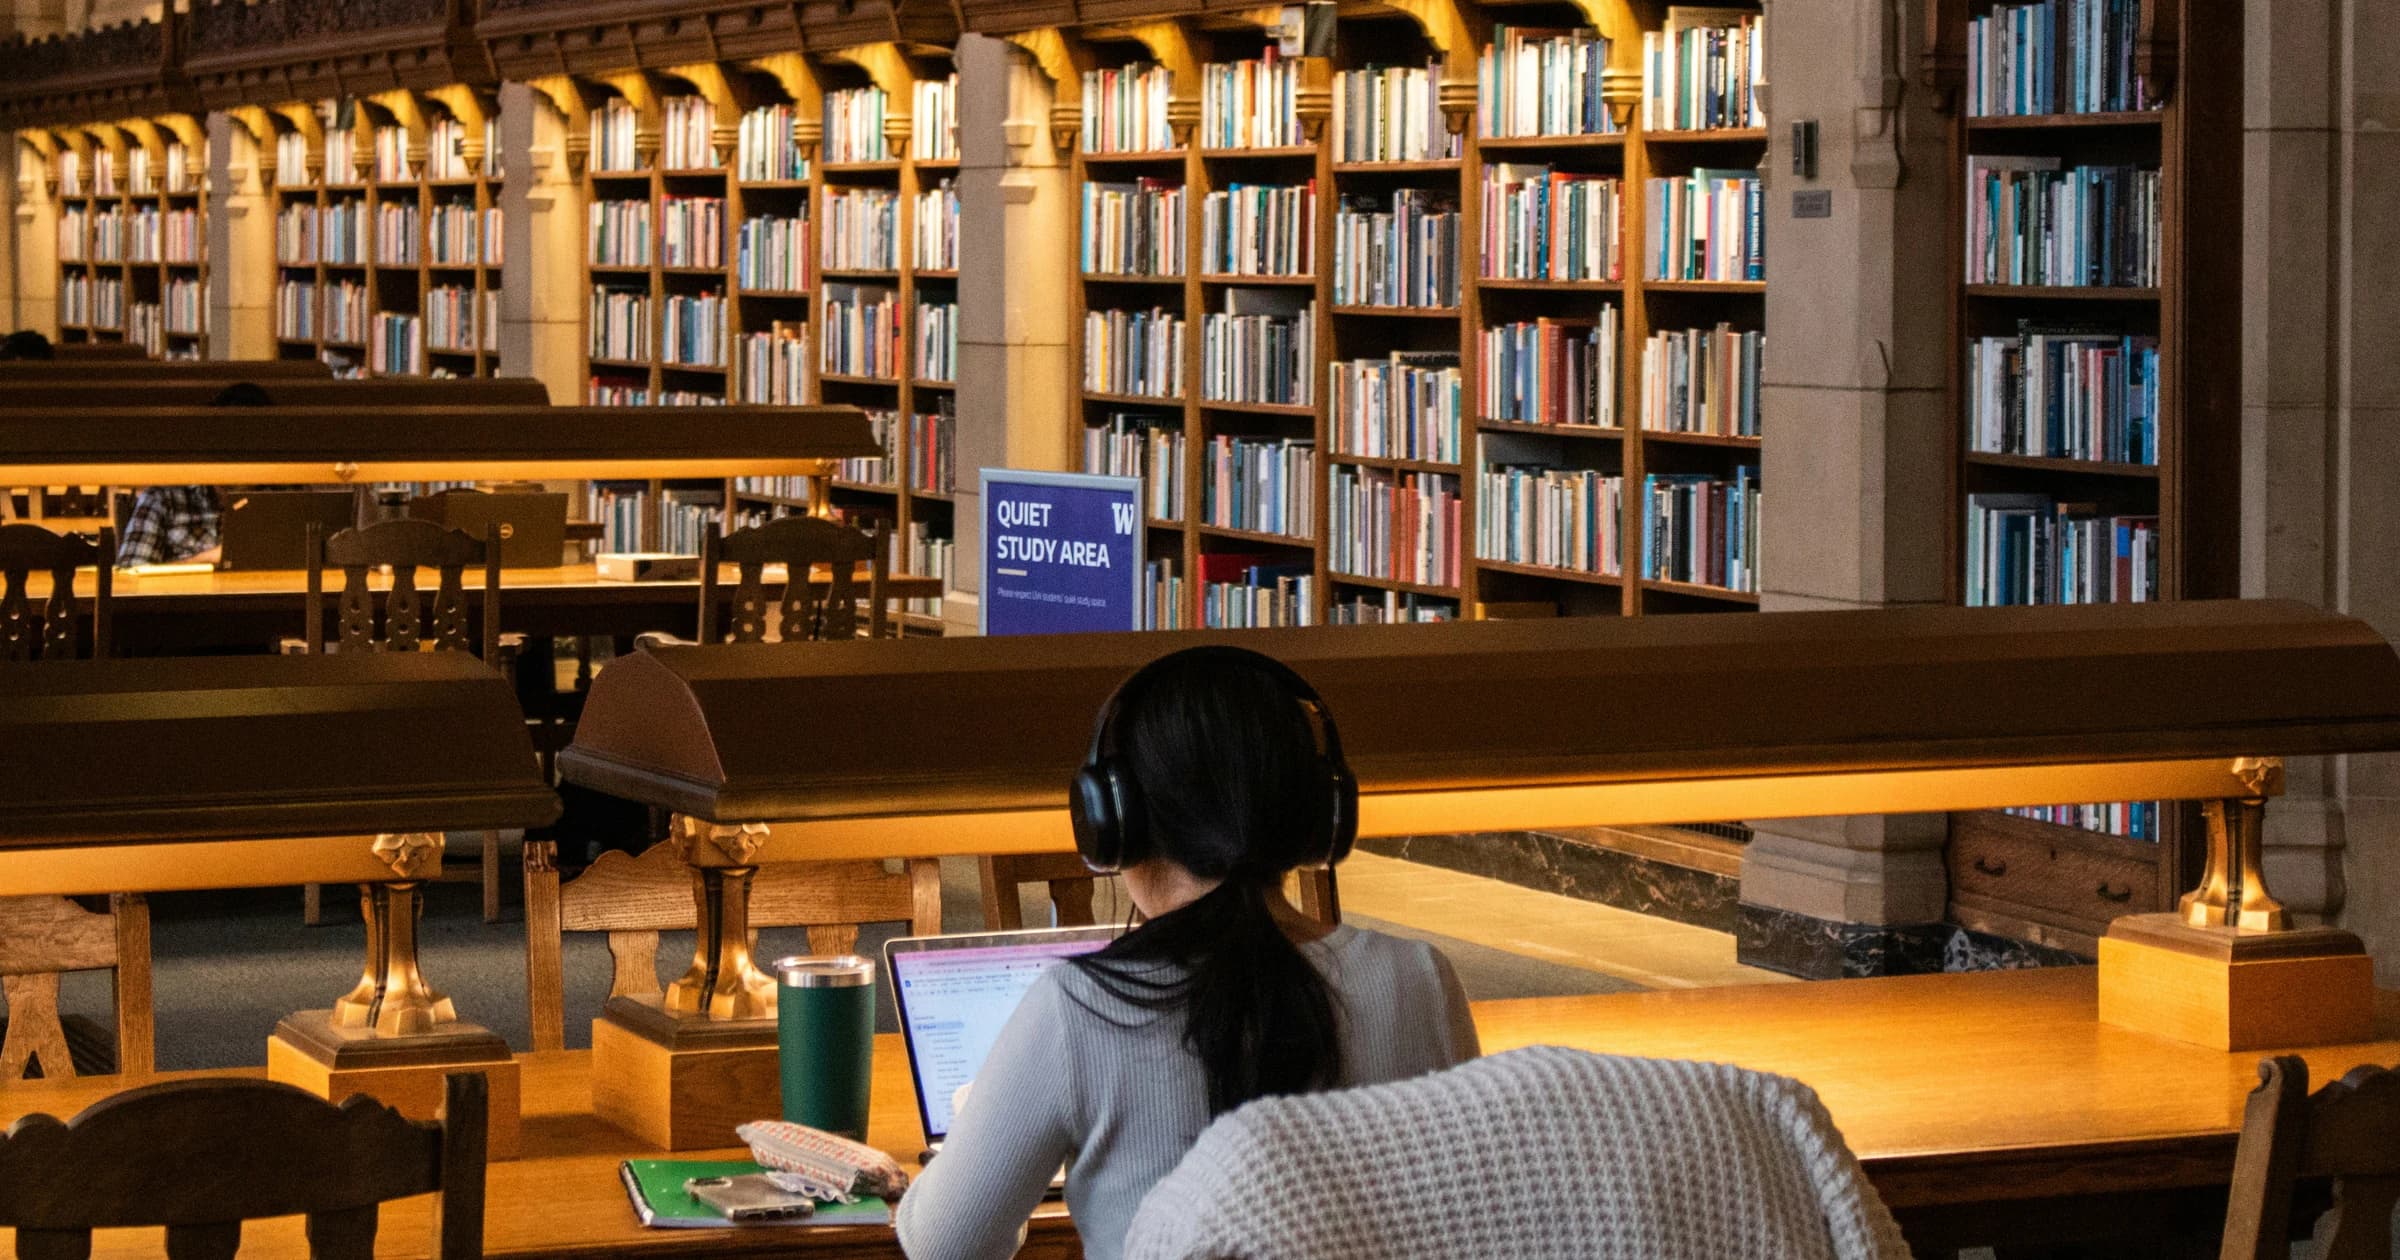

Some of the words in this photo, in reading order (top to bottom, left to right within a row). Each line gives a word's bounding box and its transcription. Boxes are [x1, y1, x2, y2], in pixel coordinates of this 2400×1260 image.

[998, 500, 1052, 528] QUIET
[1111, 502, 1135, 535] W
[998, 535, 1057, 563] STUDY
[1059, 540, 1110, 568] AREA
